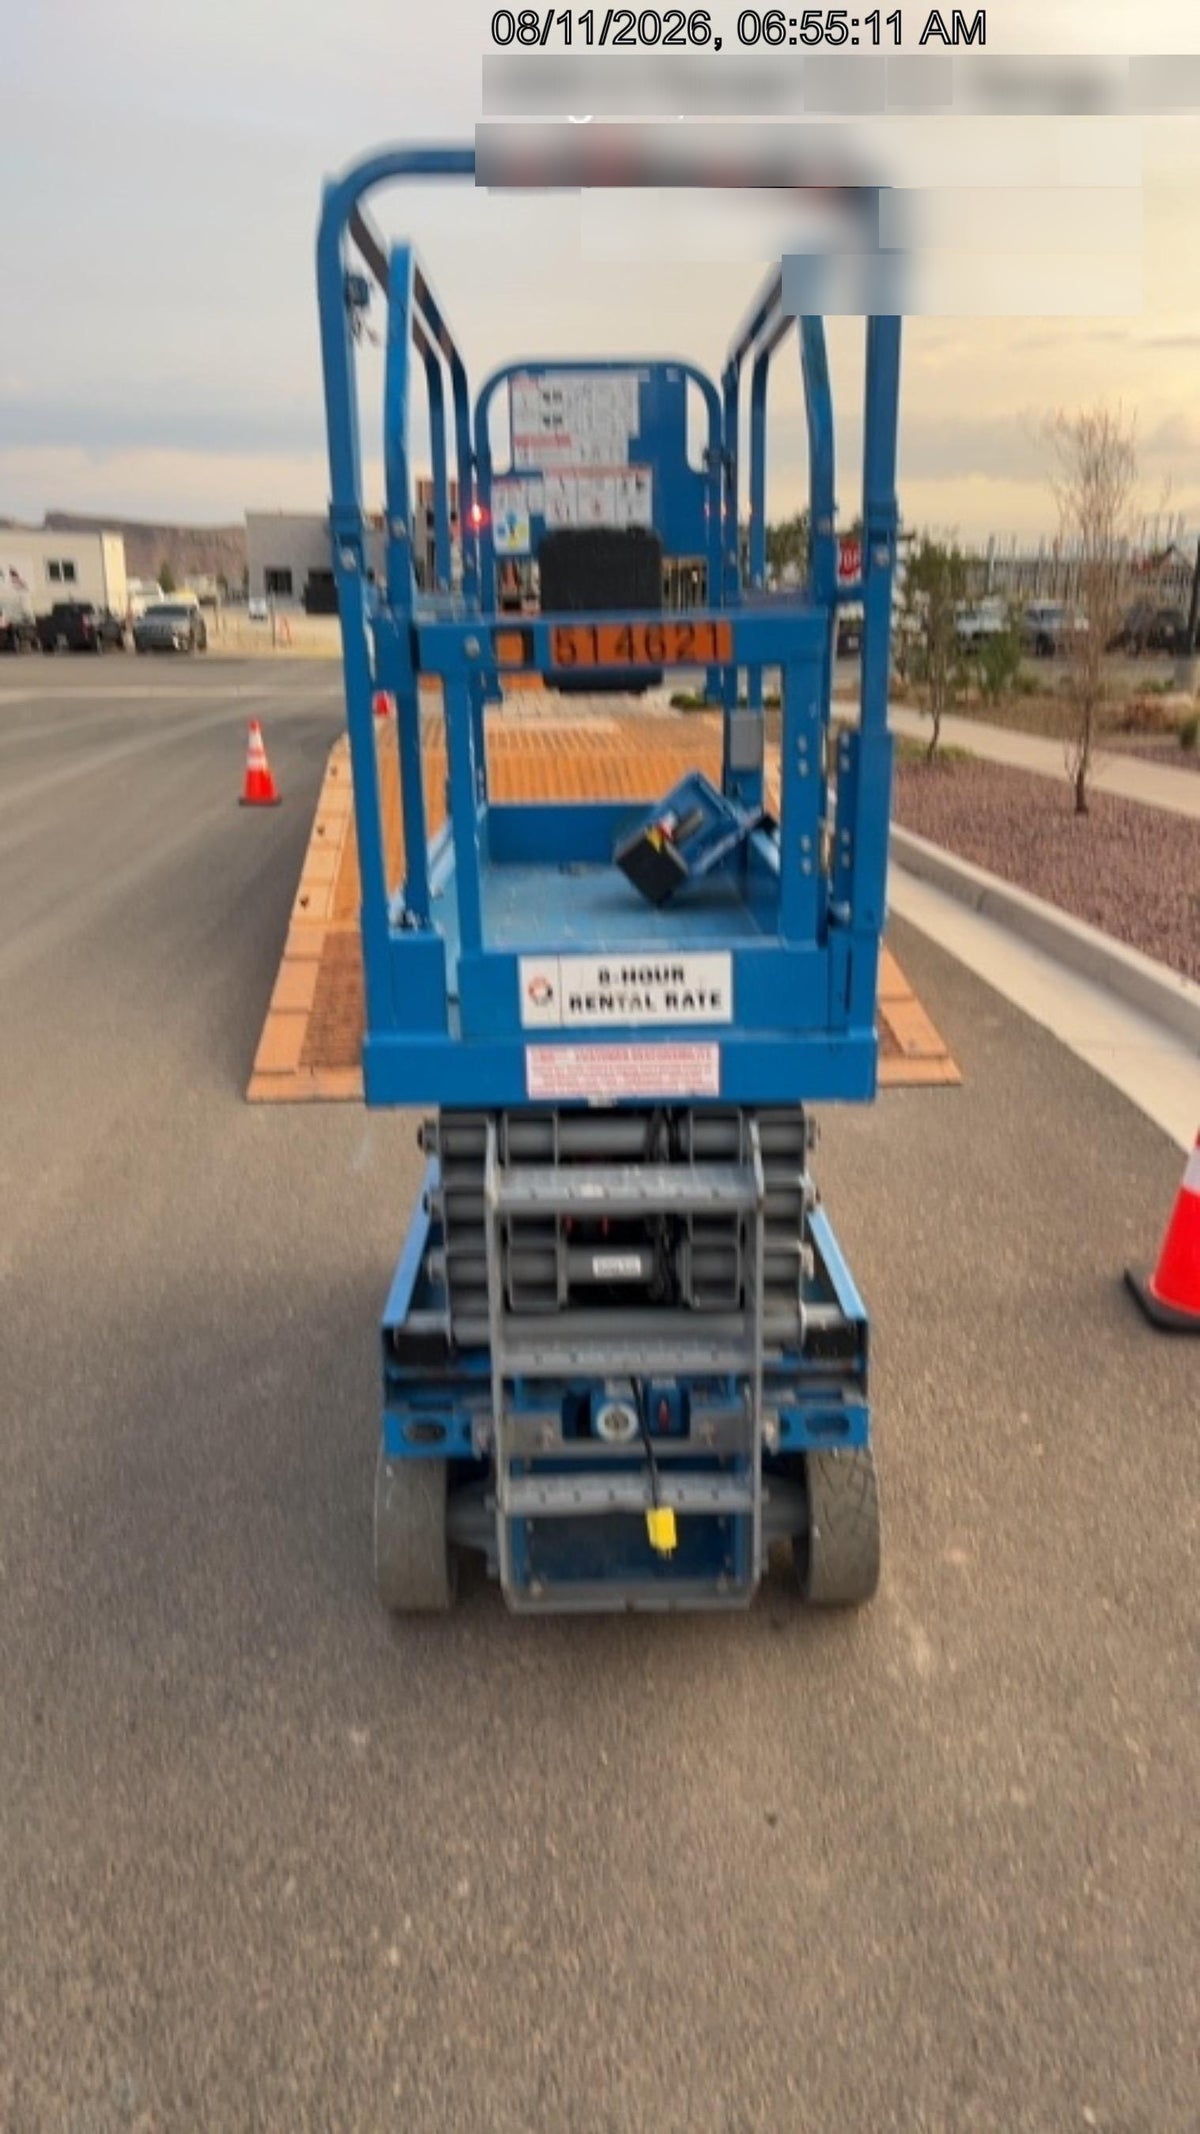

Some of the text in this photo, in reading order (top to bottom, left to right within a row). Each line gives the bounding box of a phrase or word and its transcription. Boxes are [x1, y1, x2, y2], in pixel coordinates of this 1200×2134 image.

[554, 622, 717, 666] 514621
[568, 988, 722, 1013] RENTAL RATE
